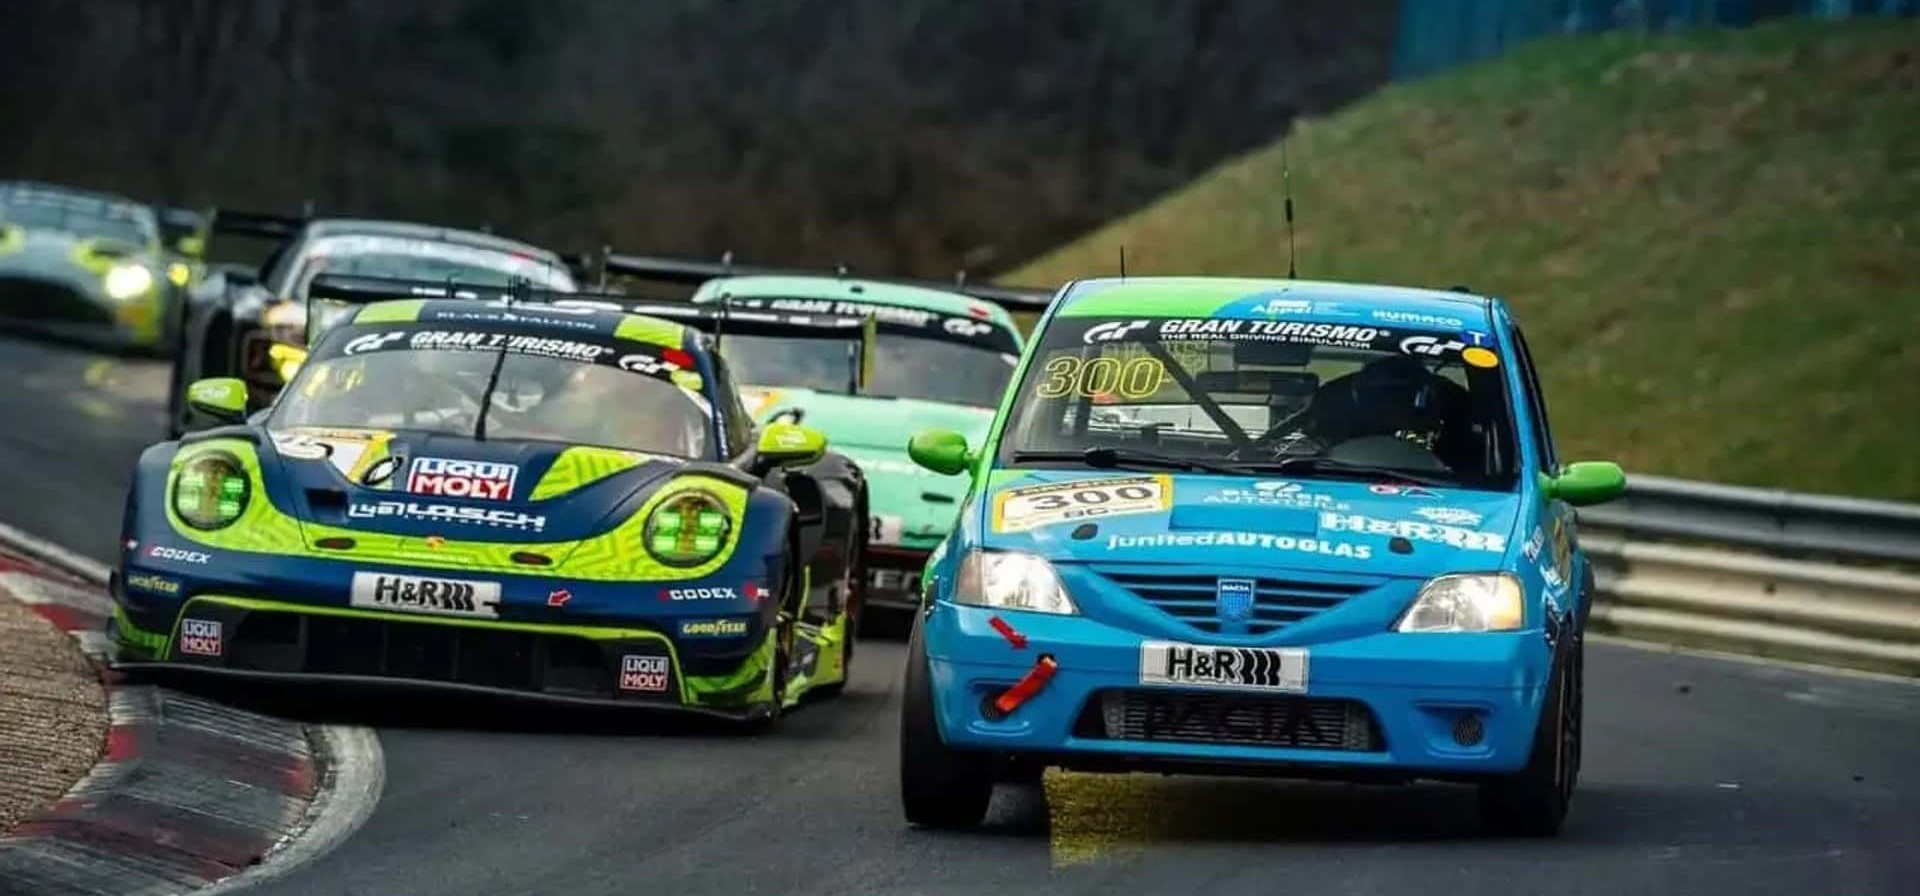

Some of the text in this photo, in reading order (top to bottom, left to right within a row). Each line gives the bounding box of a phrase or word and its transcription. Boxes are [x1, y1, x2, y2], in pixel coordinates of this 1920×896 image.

[1160, 319, 1378, 342] GRAN TURISMO
[1467, 331, 1487, 346] T
[410, 331, 487, 350] GRAN
[1161, 333, 1372, 349] THE REAL DRIVING SIMULATOR
[1036, 356, 1165, 399] 300
[419, 459, 508, 480] LIQUI
[414, 476, 508, 500] MOLY
[1028, 486, 1154, 511] 300
[151, 546, 213, 564] CODEX
[374, 576, 439, 607] H&R
[669, 587, 738, 600] CODEX
[184, 620, 217, 637] LIQUI
[183, 637, 218, 653] MOLY
[624, 658, 666, 673] LIQUI
[1167, 647, 1237, 680] H&R
[623, 673, 666, 688] MOLY
